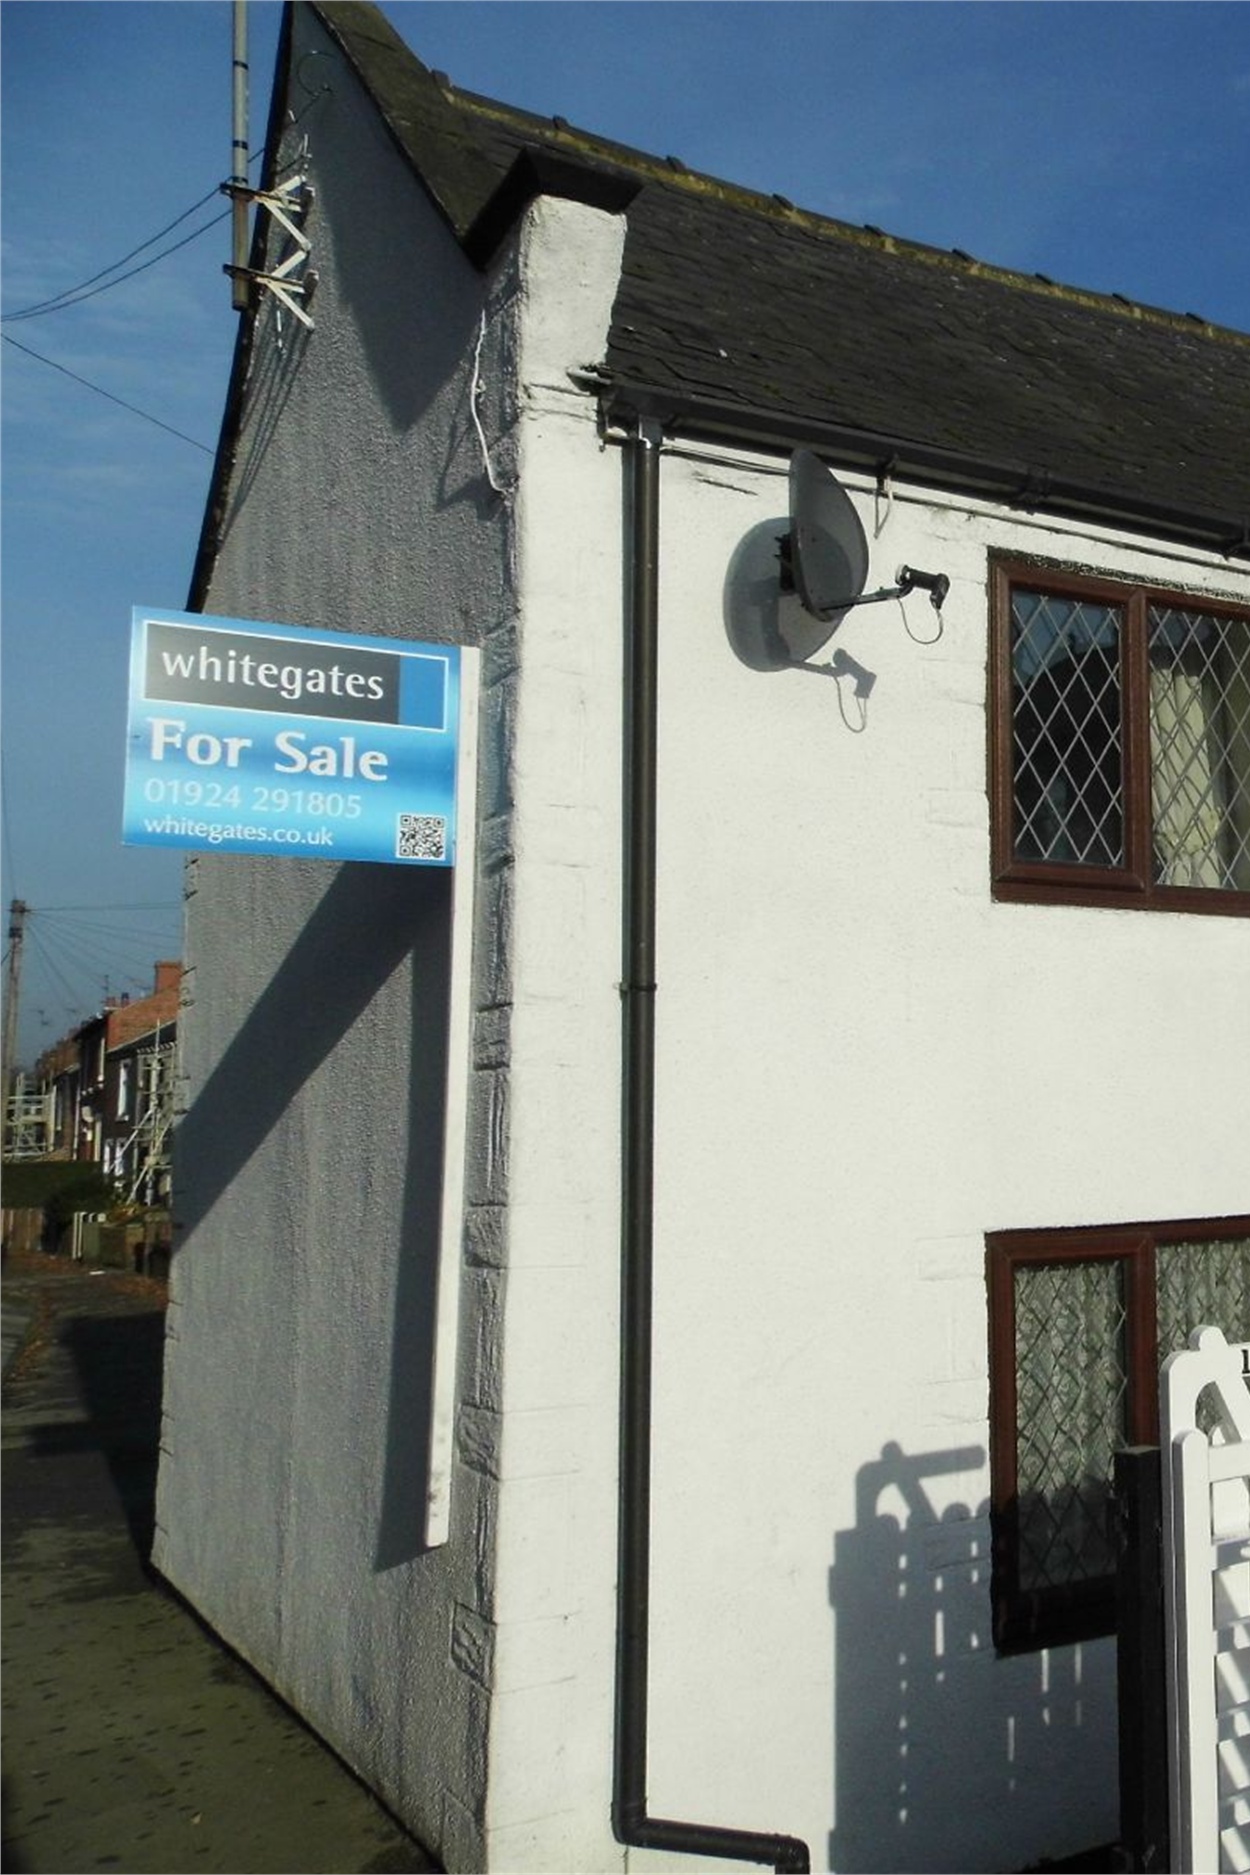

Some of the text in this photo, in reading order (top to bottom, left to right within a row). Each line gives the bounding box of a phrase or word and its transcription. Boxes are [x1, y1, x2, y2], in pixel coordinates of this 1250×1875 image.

[161, 646, 384, 700] whitegates
[147, 717, 389, 782] For Sale
[144, 777, 362, 819] 01924 291805
[143, 814, 333, 846] whitegates.co.uk
